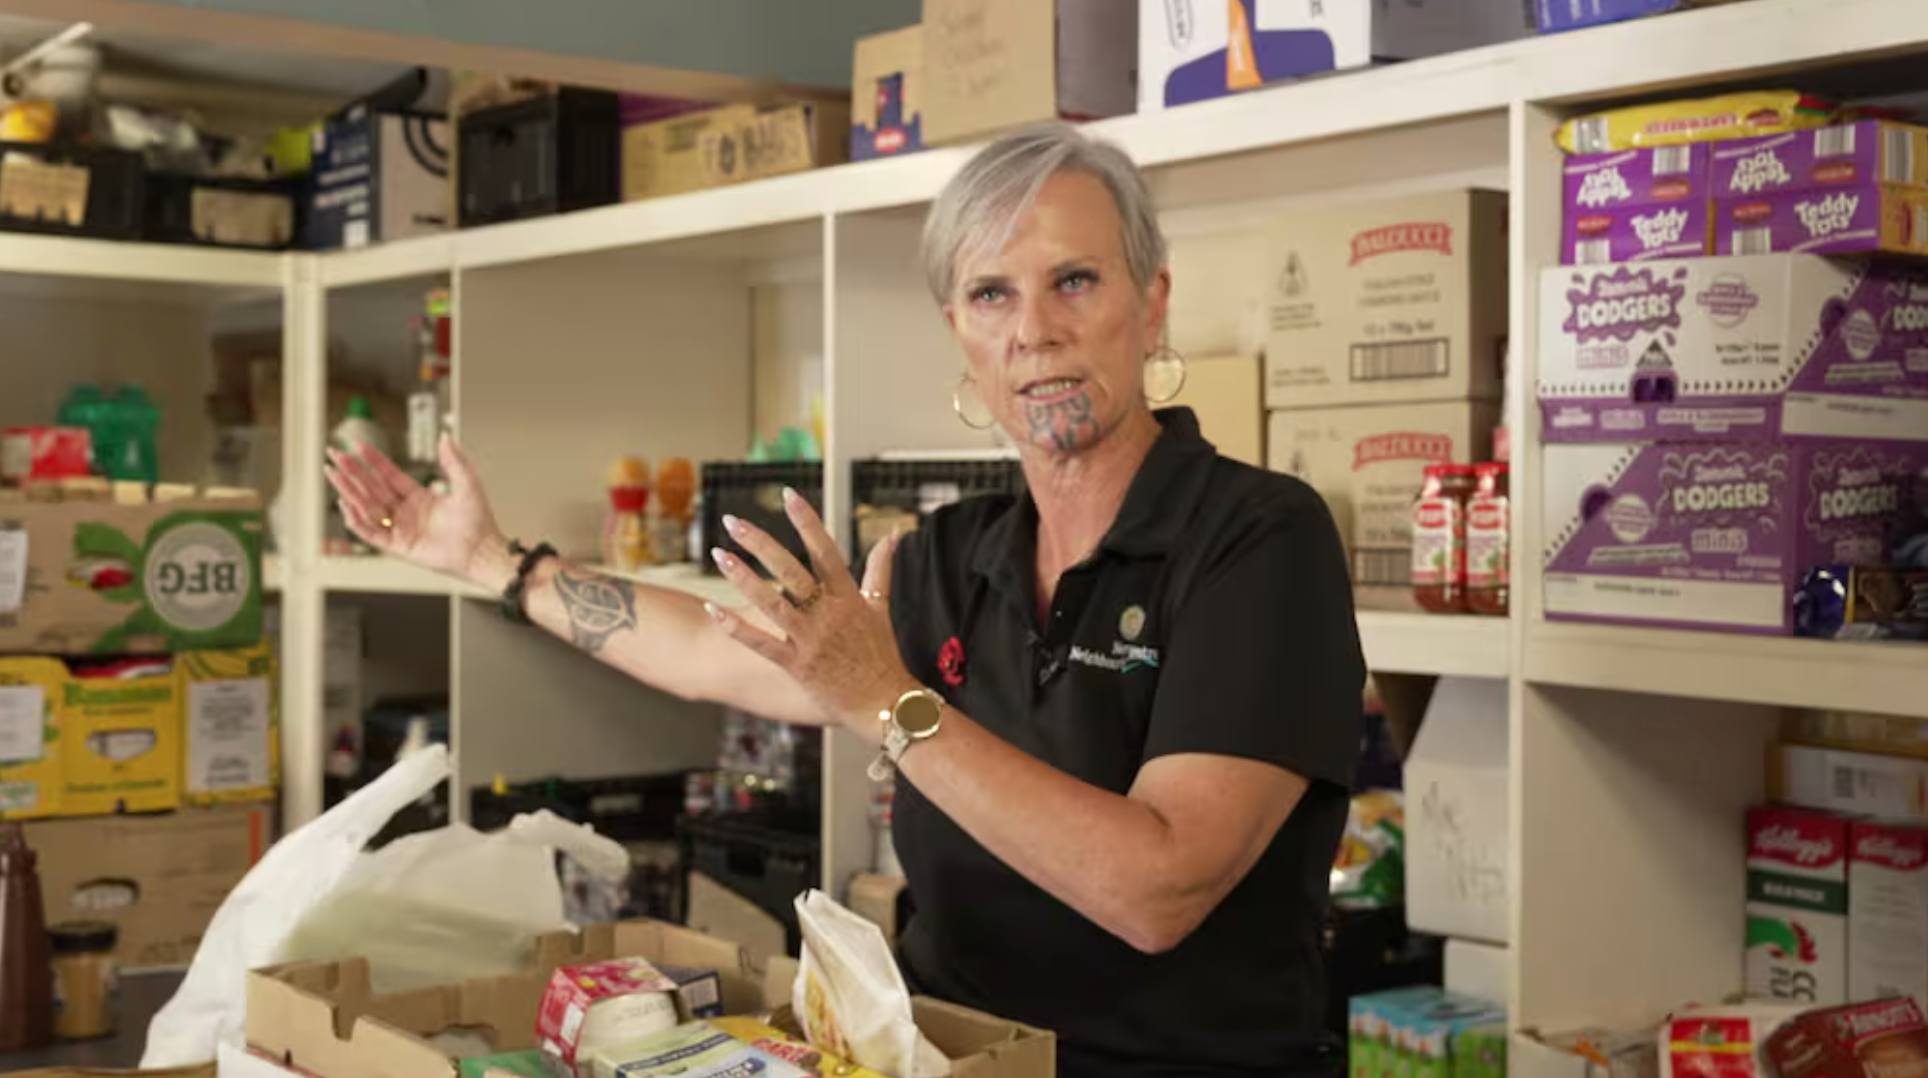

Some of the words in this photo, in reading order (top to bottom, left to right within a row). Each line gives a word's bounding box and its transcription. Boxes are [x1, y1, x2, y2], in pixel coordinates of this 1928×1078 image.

[1576, 178, 1632, 208] Teddy
[1729, 165, 1791, 194] Teddy
[1630, 206, 1689, 236] Teddy
[1793, 191, 1860, 225] Teddy
[1641, 225, 1679, 250] Tots
[1806, 215, 1850, 238] Tots
[1576, 294, 1671, 330] DODGERS
[1673, 482, 1770, 513] DODGERS
[158, 561, 238, 595] BFG
